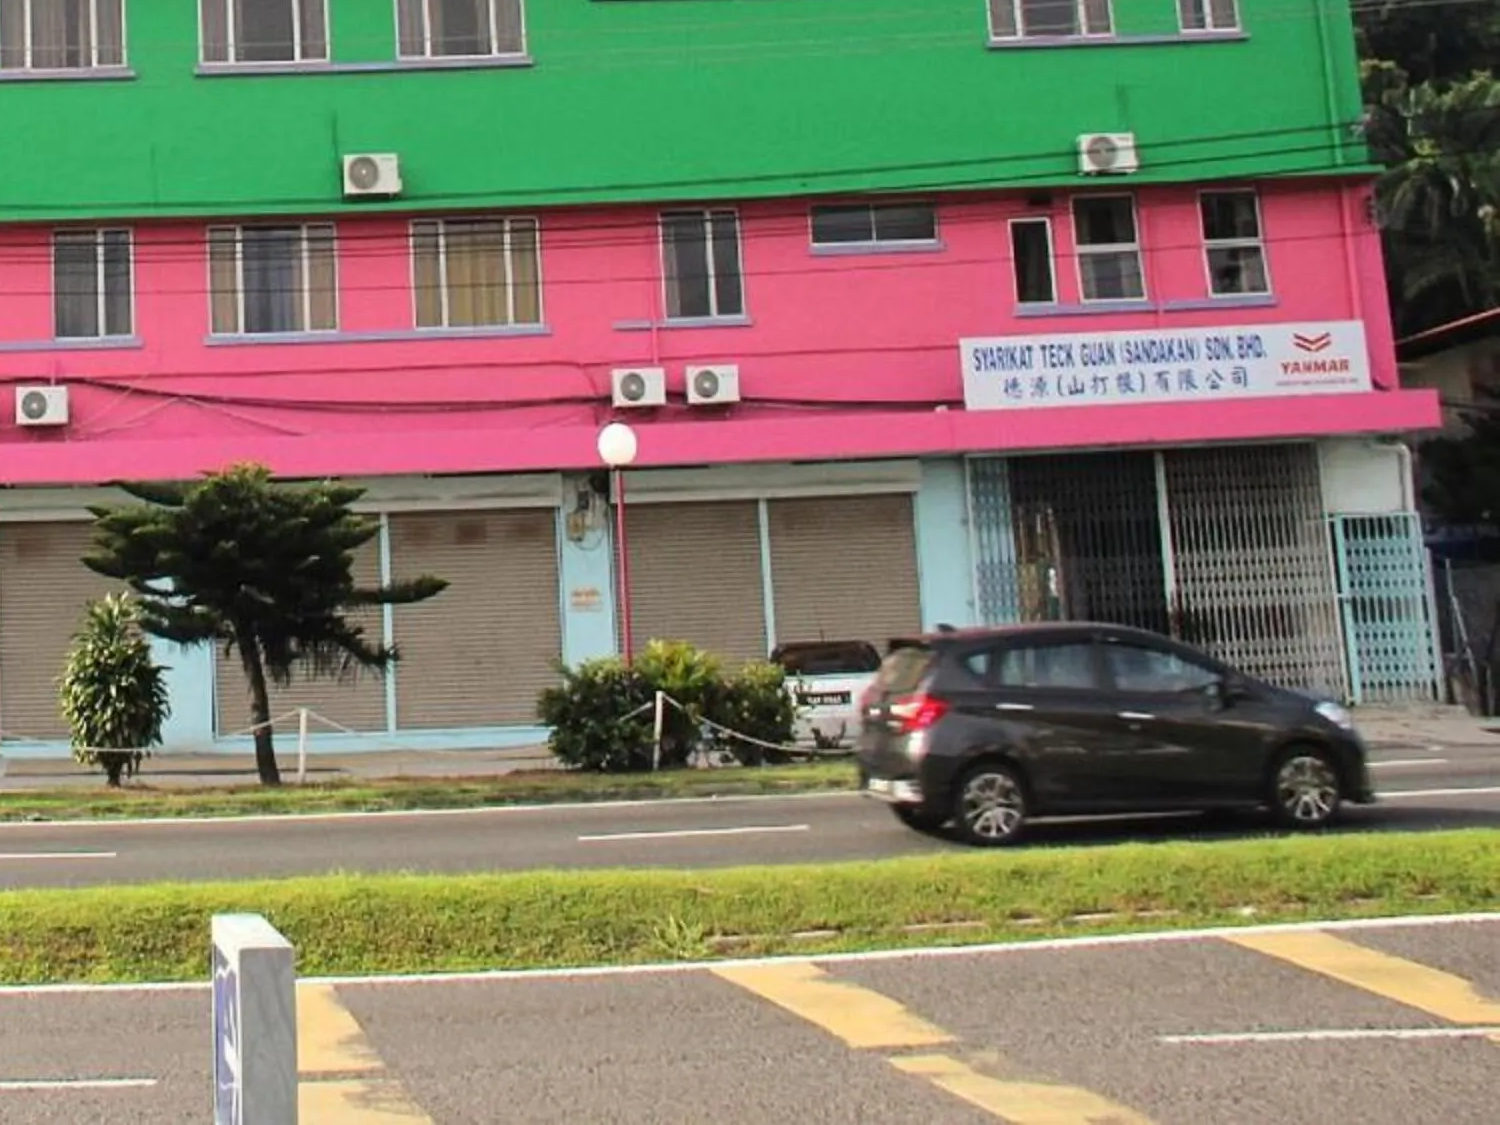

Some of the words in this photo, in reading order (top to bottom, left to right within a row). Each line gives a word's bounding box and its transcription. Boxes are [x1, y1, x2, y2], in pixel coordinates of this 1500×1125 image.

[972, 345, 1034, 372] SYARIKAT
[1040, 343, 1076, 369] TECK
[1079, 341, 1117, 367] GUAN
[1119, 337, 1200, 365] (SANDAKAN)
[1281, 358, 1350, 375] YANMAR
